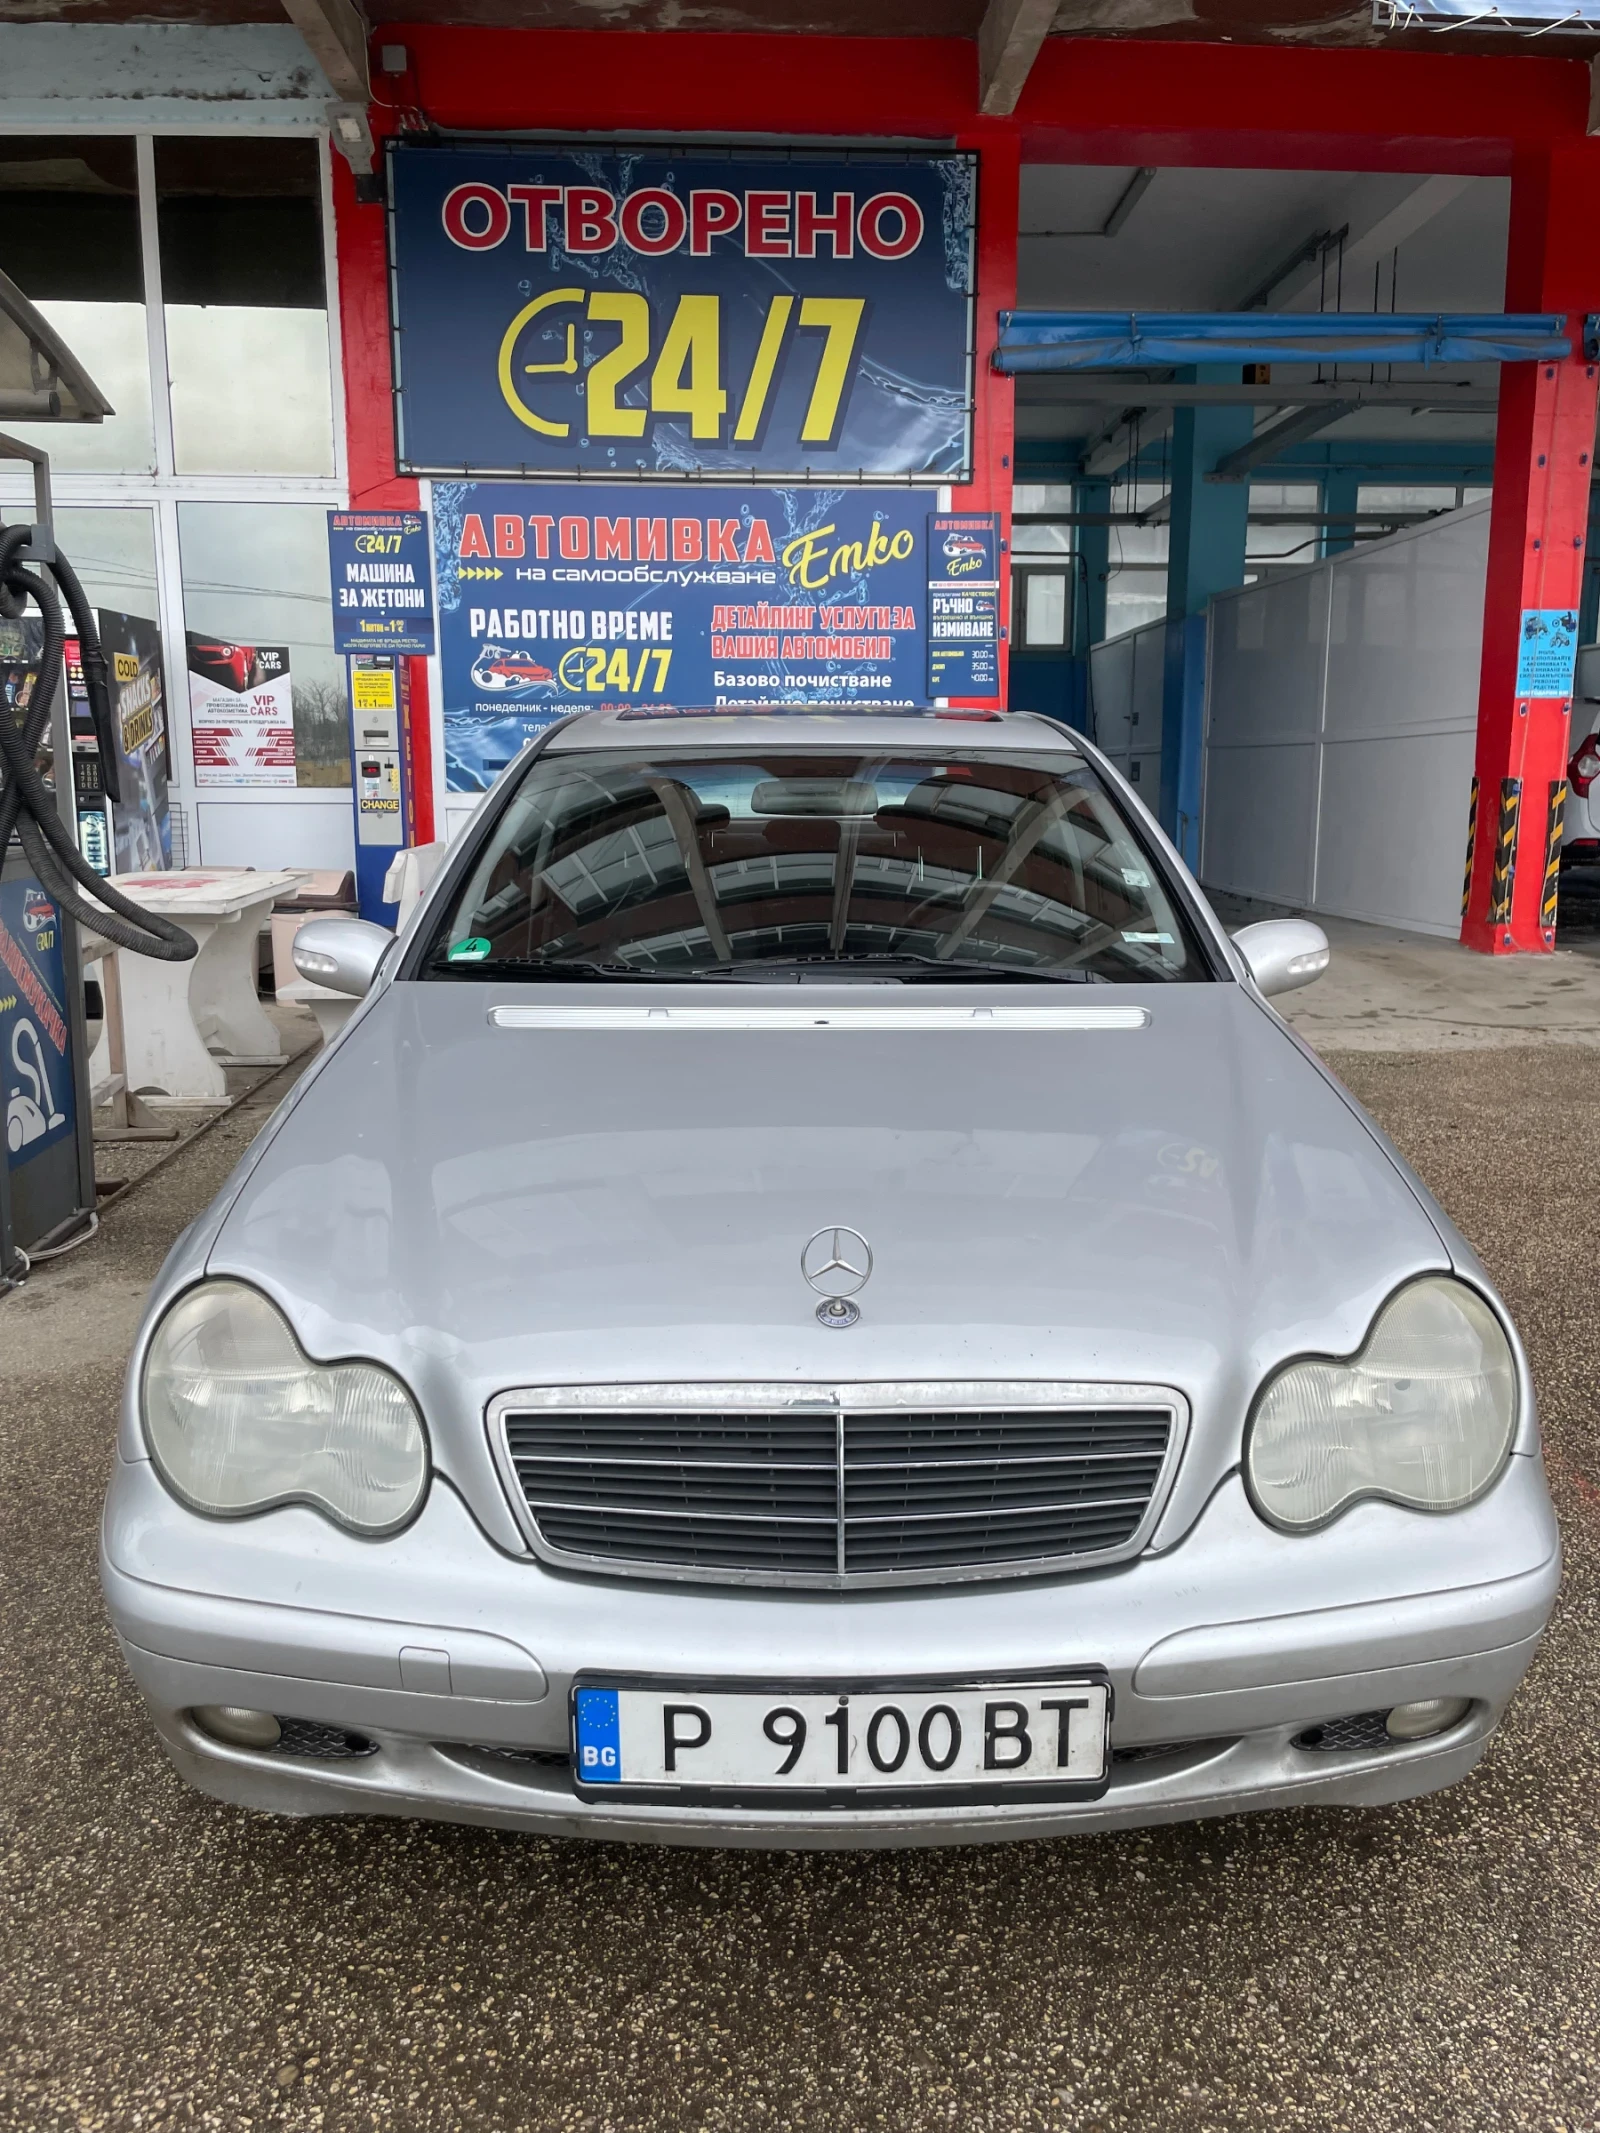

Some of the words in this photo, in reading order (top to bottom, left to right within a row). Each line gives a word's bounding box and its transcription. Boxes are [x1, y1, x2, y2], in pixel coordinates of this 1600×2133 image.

[442, 182, 924, 260] ОТВОРЕНО
[587, 292, 865, 441] 24/7
[333, 515, 402, 527] АВТОМИВКА
[934, 520, 995, 530] АВТОМИВКА
[366, 535, 402, 553] 24/7
[458, 514, 776, 563] АВТОМИВКА
[346, 563, 415, 583] МАШИНА
[516, 567, 546, 581] на
[552, 565, 776, 587] самообслужване
[339, 588, 358, 607] ЗА
[361, 588, 425, 608] ЖЕТОНИ
[932, 598, 973, 614] РЪЧНО
[470, 608, 585, 639] РАБОТНО
[591, 611, 673, 641] ВРЕМЕ
[711, 601, 816, 632] ДЕТАЙЛИНГ
[819, 606, 891, 630] УСЛУГИ
[892, 606, 916, 630] ЗА
[932, 621, 993, 637] ИЗМИВАНЕ
[261, 652, 279, 661] VIP
[711, 635, 778, 660] ВАШИЯ
[781, 635, 892, 660] АВТОМОБИЛ
[118, 659, 139, 677] COLD
[259, 661, 282, 670] CARS
[586, 647, 673, 693] 24/7
[714, 671, 780, 687] Базово
[785, 675, 892, 688] почистване
[120, 673, 151, 720] SNACKS
[253, 695, 275, 706] VIP
[250, 706, 278, 716] CARS
[475, 702, 542, 714] понеделник
[129, 706, 153, 746] DRINKS
[361, 800, 399, 810] CHANGE
[86, 831, 101, 863] HELL
[465, 939, 478, 951] 4
[662, 1703, 712, 1771] P
[583, 1746, 616, 1766] BG
